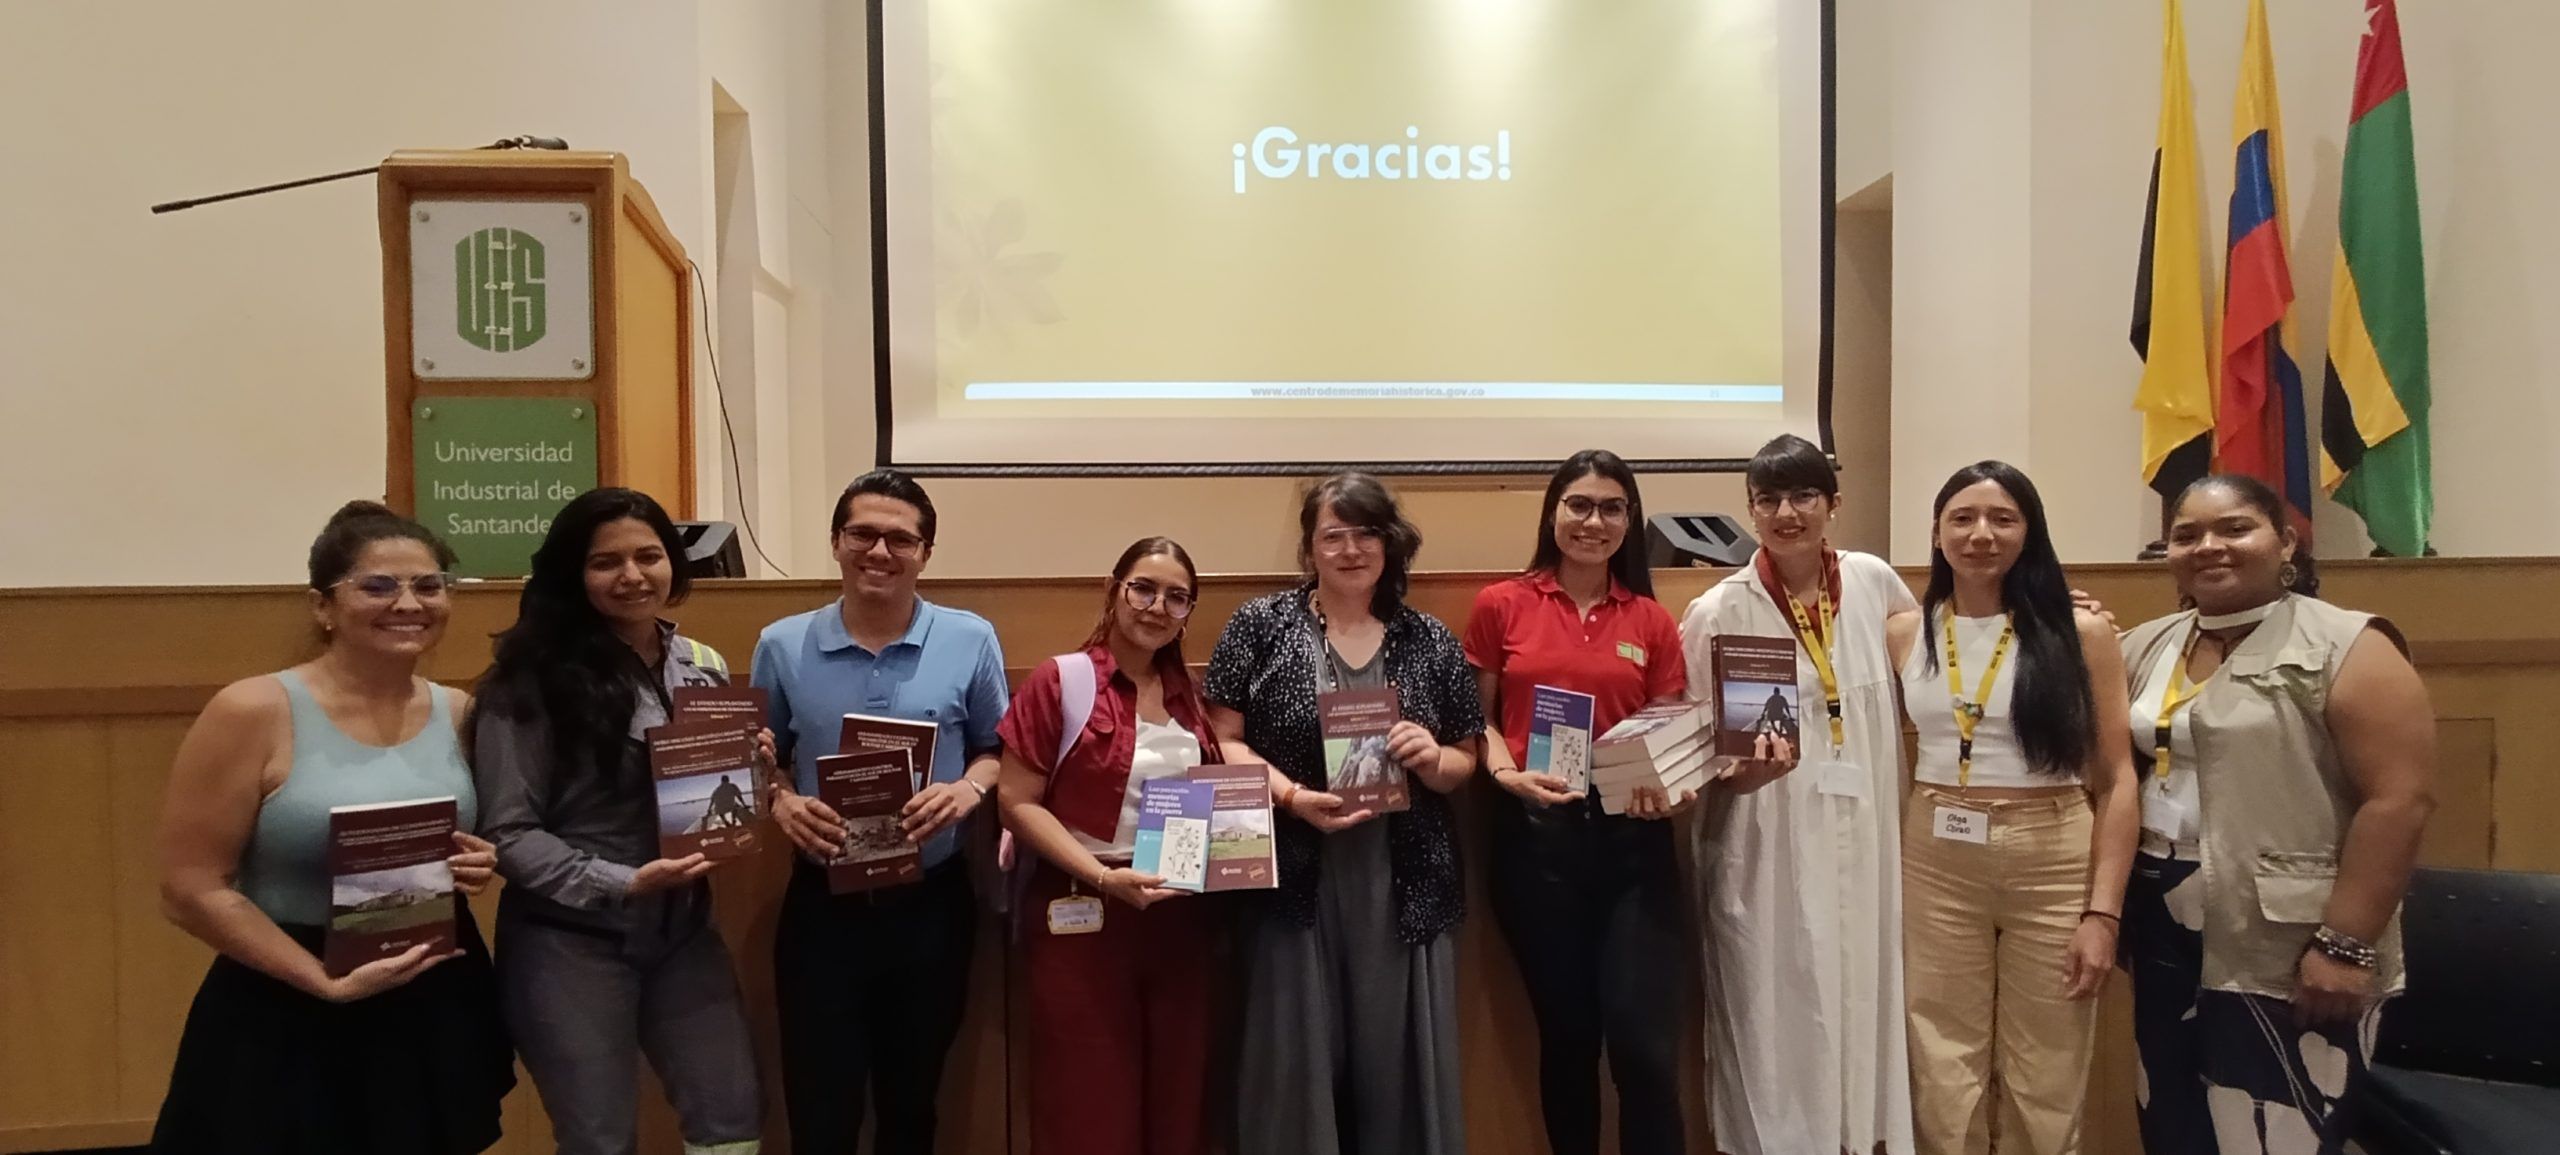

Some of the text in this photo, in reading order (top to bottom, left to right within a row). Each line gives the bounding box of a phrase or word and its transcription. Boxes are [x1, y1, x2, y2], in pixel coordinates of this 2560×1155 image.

[1232, 125, 1511, 193] ¡Gracias!
[1250, 386, 1485, 398] www.centrodememoriahistorica.gov.co
[434, 440, 573, 463] Universidad
[434, 480, 576, 501] Industrial de
[448, 513, 553, 535] Santande
